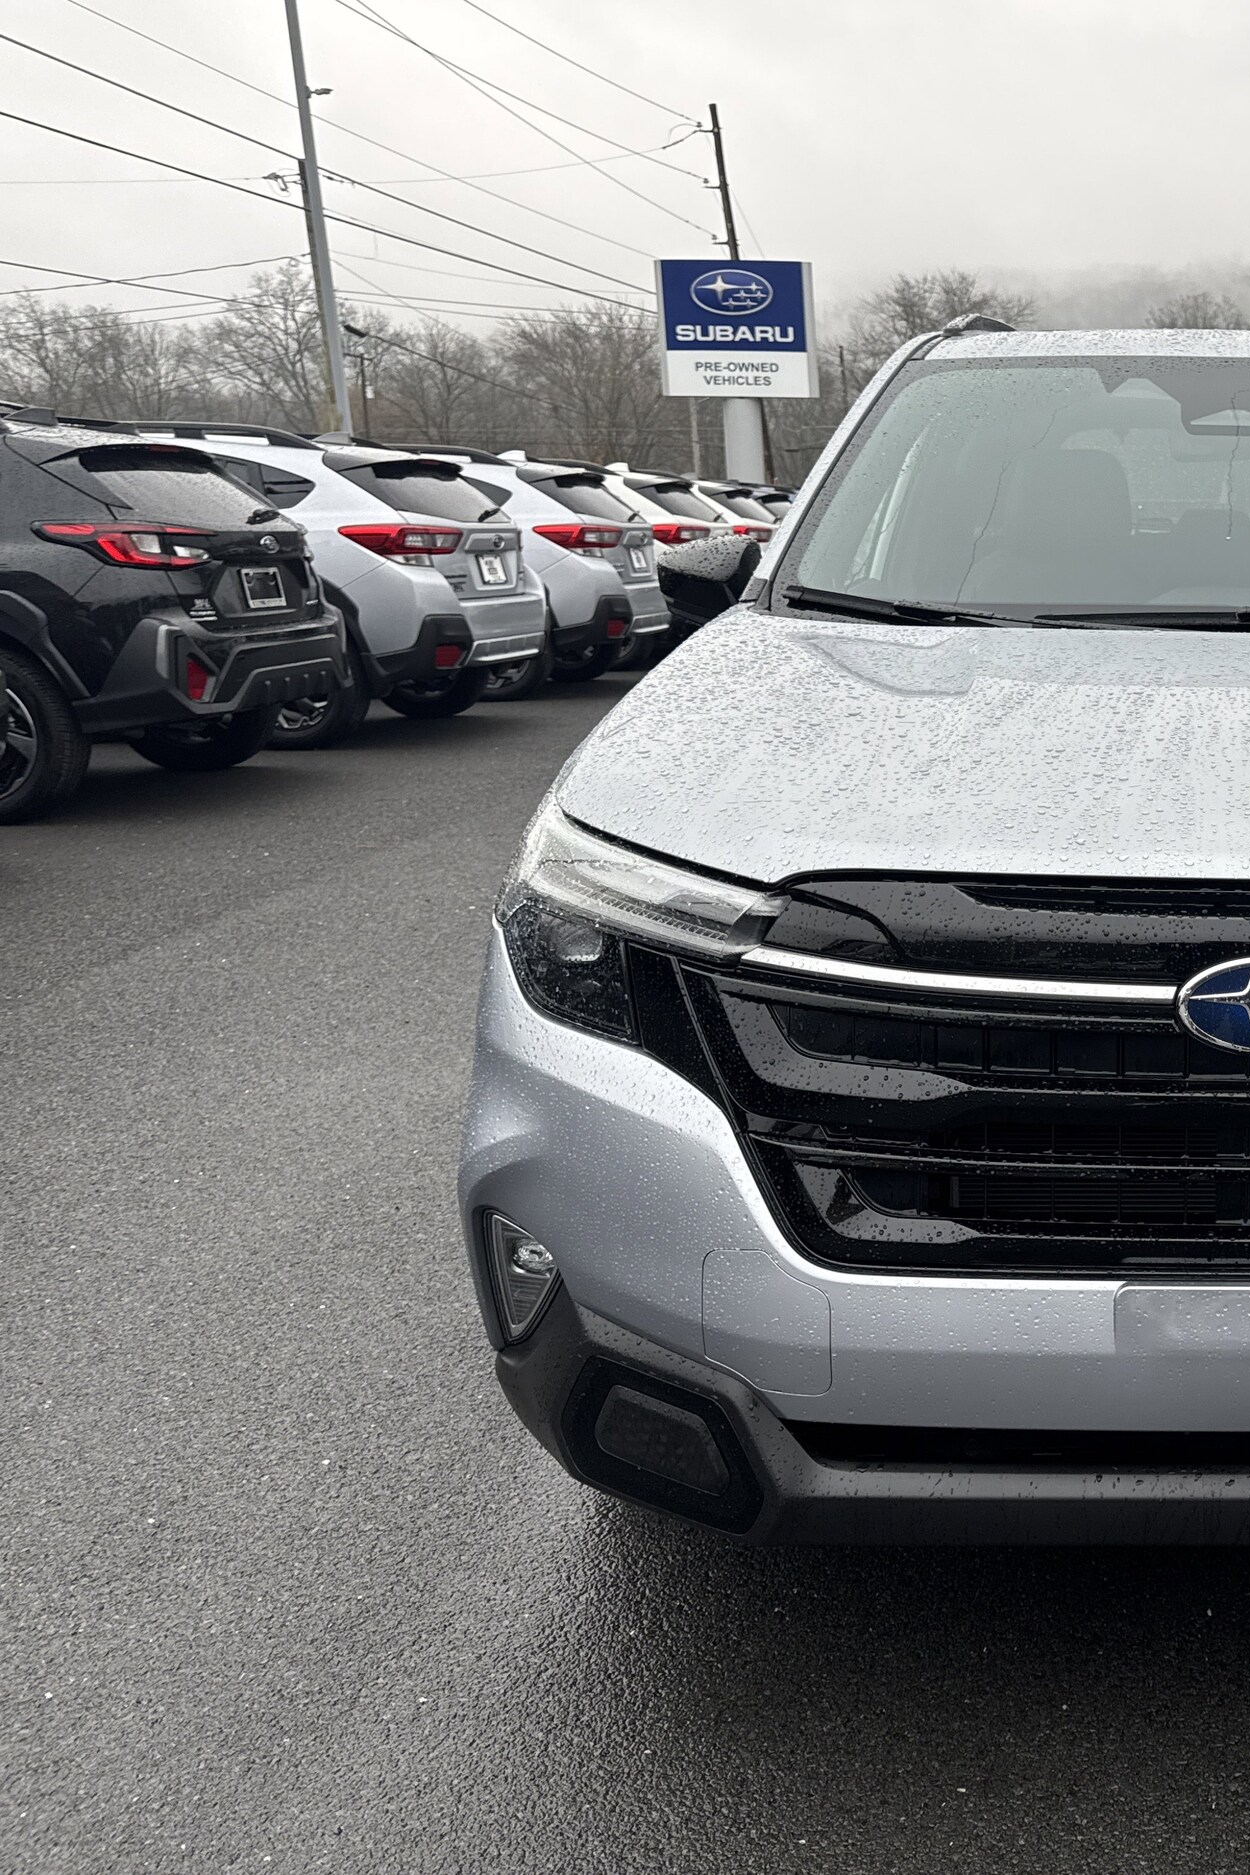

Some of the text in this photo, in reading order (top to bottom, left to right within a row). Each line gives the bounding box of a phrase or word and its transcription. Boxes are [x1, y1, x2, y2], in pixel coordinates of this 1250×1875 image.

[675, 324, 795, 343] SUBARU
[694, 361, 779, 373] PRE-OWNED
[703, 375, 772, 387] VEHICLES
